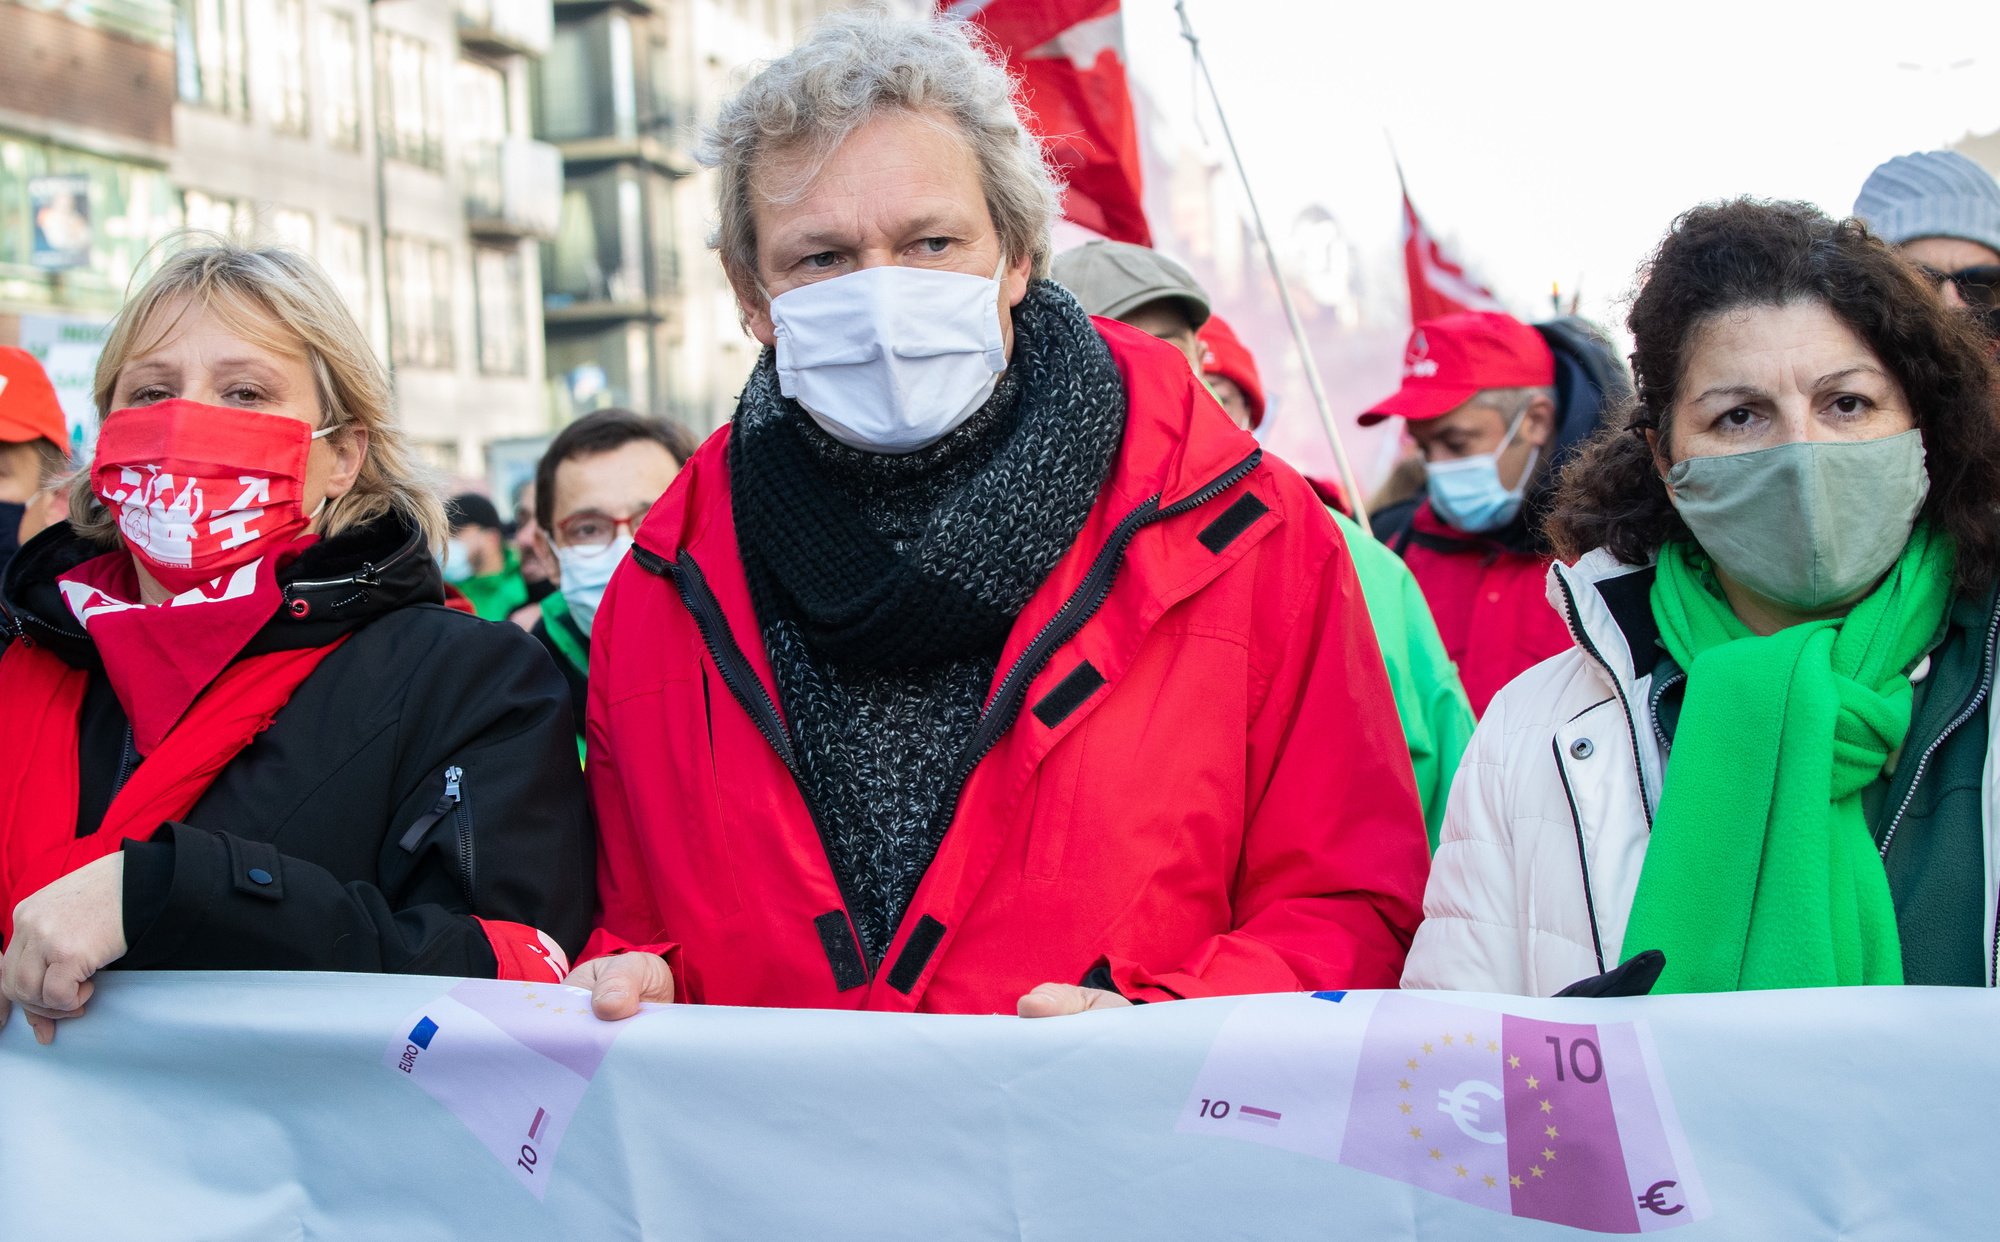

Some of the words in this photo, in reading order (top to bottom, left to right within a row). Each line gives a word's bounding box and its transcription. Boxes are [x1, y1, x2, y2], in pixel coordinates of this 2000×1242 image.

[398, 1044, 419, 1074] EURO
[1545, 1036, 1603, 1084] 10
[1200, 1098, 1231, 1120] 10
[517, 1144, 538, 1175] 10
[1637, 1180, 1685, 1216] €
